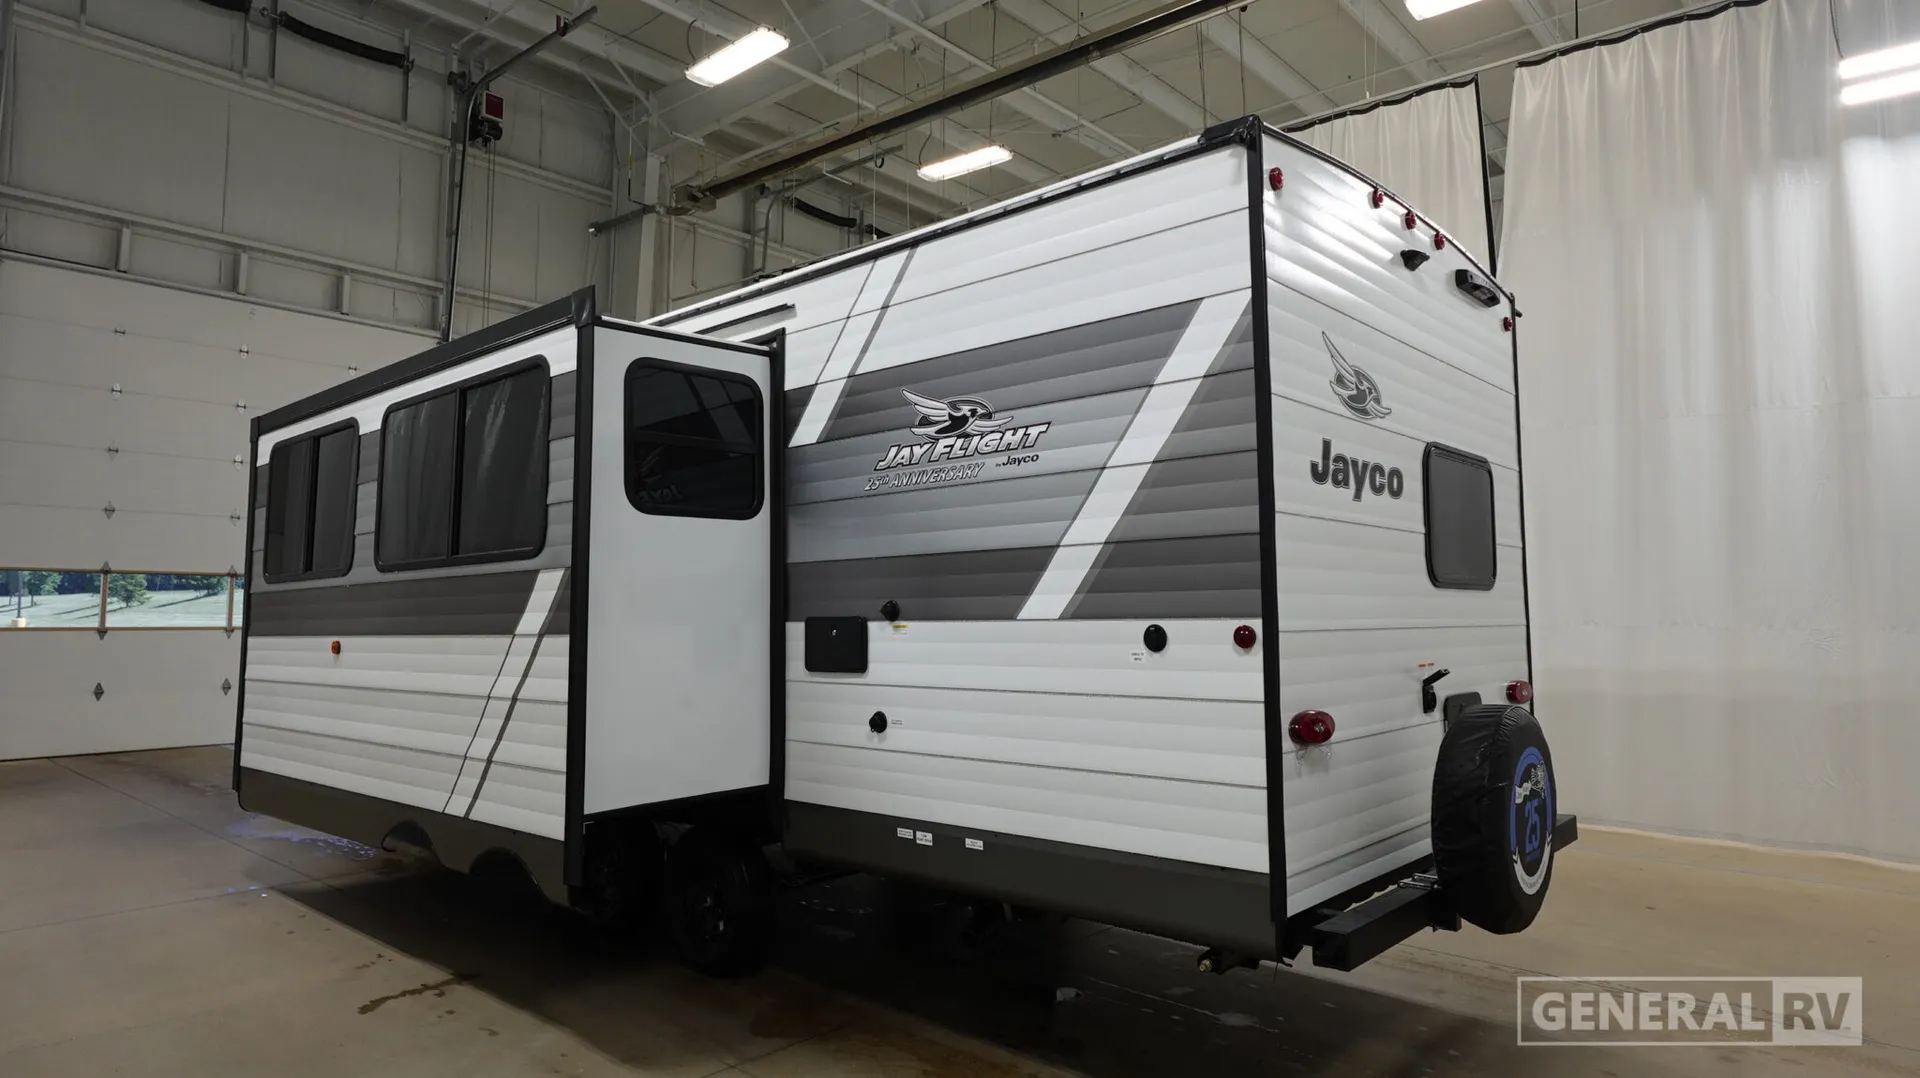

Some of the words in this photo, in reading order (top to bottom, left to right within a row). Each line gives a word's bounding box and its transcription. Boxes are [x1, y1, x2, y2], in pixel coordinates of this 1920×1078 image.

[874, 442, 934, 471] JAY
[928, 421, 1052, 463] FLIGHT
[1002, 454, 1040, 467] Jayco
[1309, 437, 1404, 502] Jayco
[864, 475, 889, 491] 25th
[889, 462, 985, 489] ANNIVERSARY
[1525, 799, 1540, 853] 25
